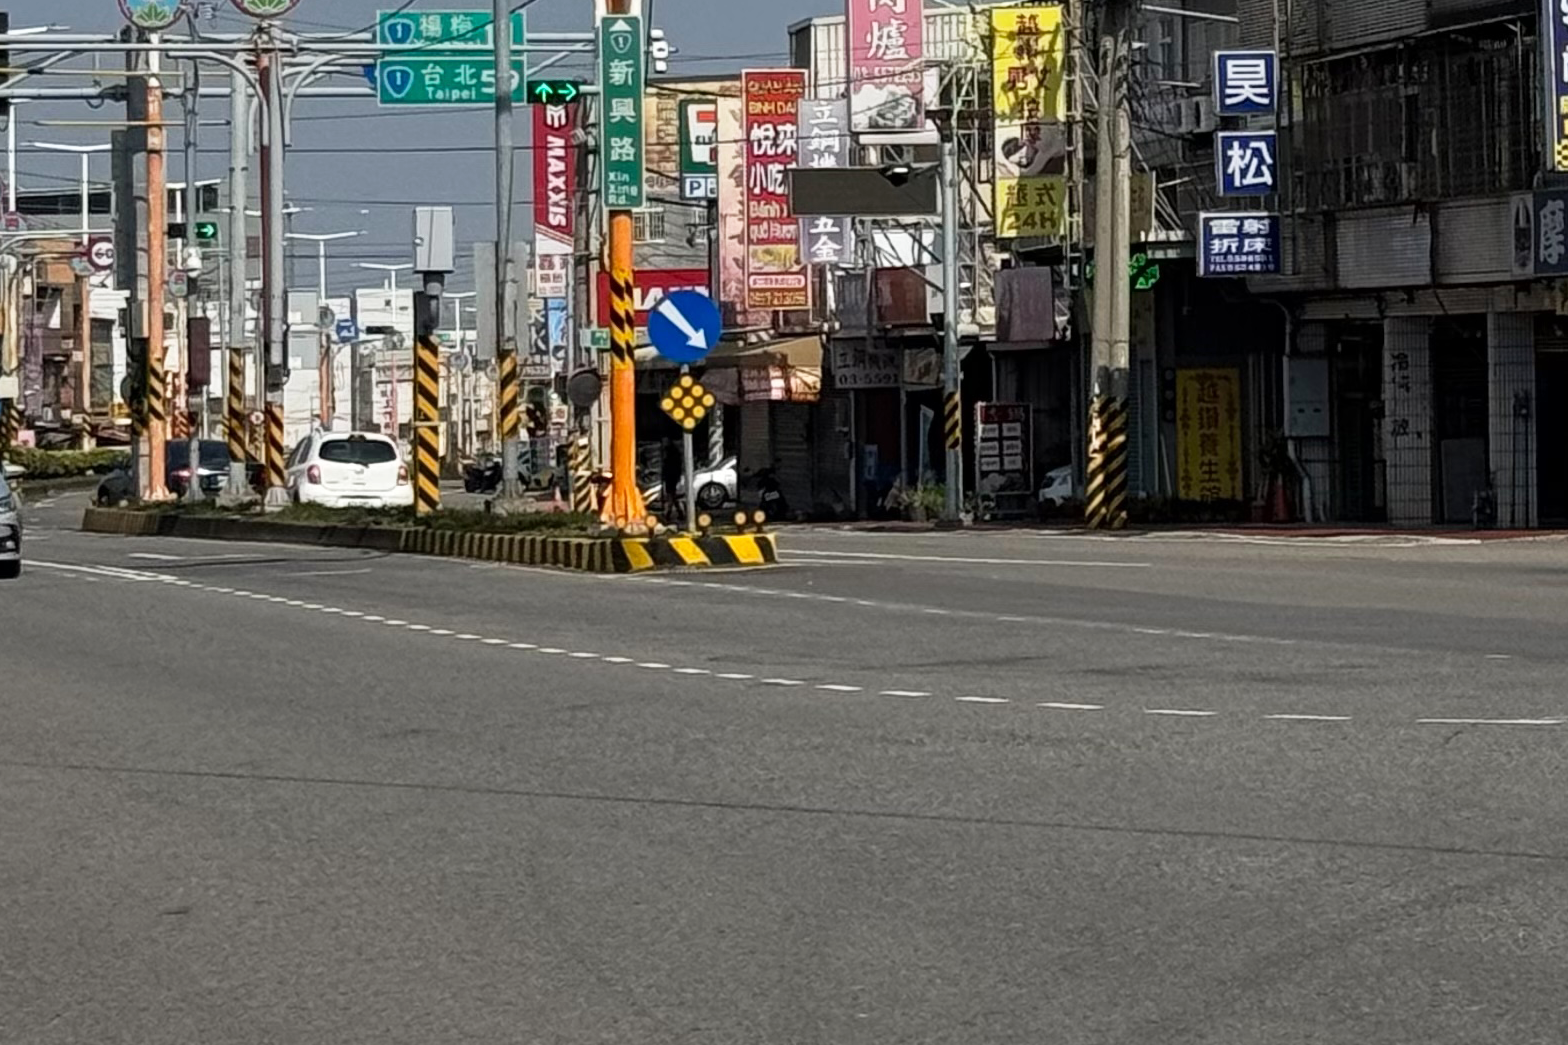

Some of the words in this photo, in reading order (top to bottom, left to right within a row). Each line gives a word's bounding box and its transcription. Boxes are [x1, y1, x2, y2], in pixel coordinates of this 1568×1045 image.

[421, 63, 478, 86] 台北
[426, 86, 477, 101] Taipei
[608, 58, 637, 162] 新興路
[547, 136, 568, 228] MAXXIS
[608, 172, 630, 183] Xin
[749, 160, 797, 194] 小吃
